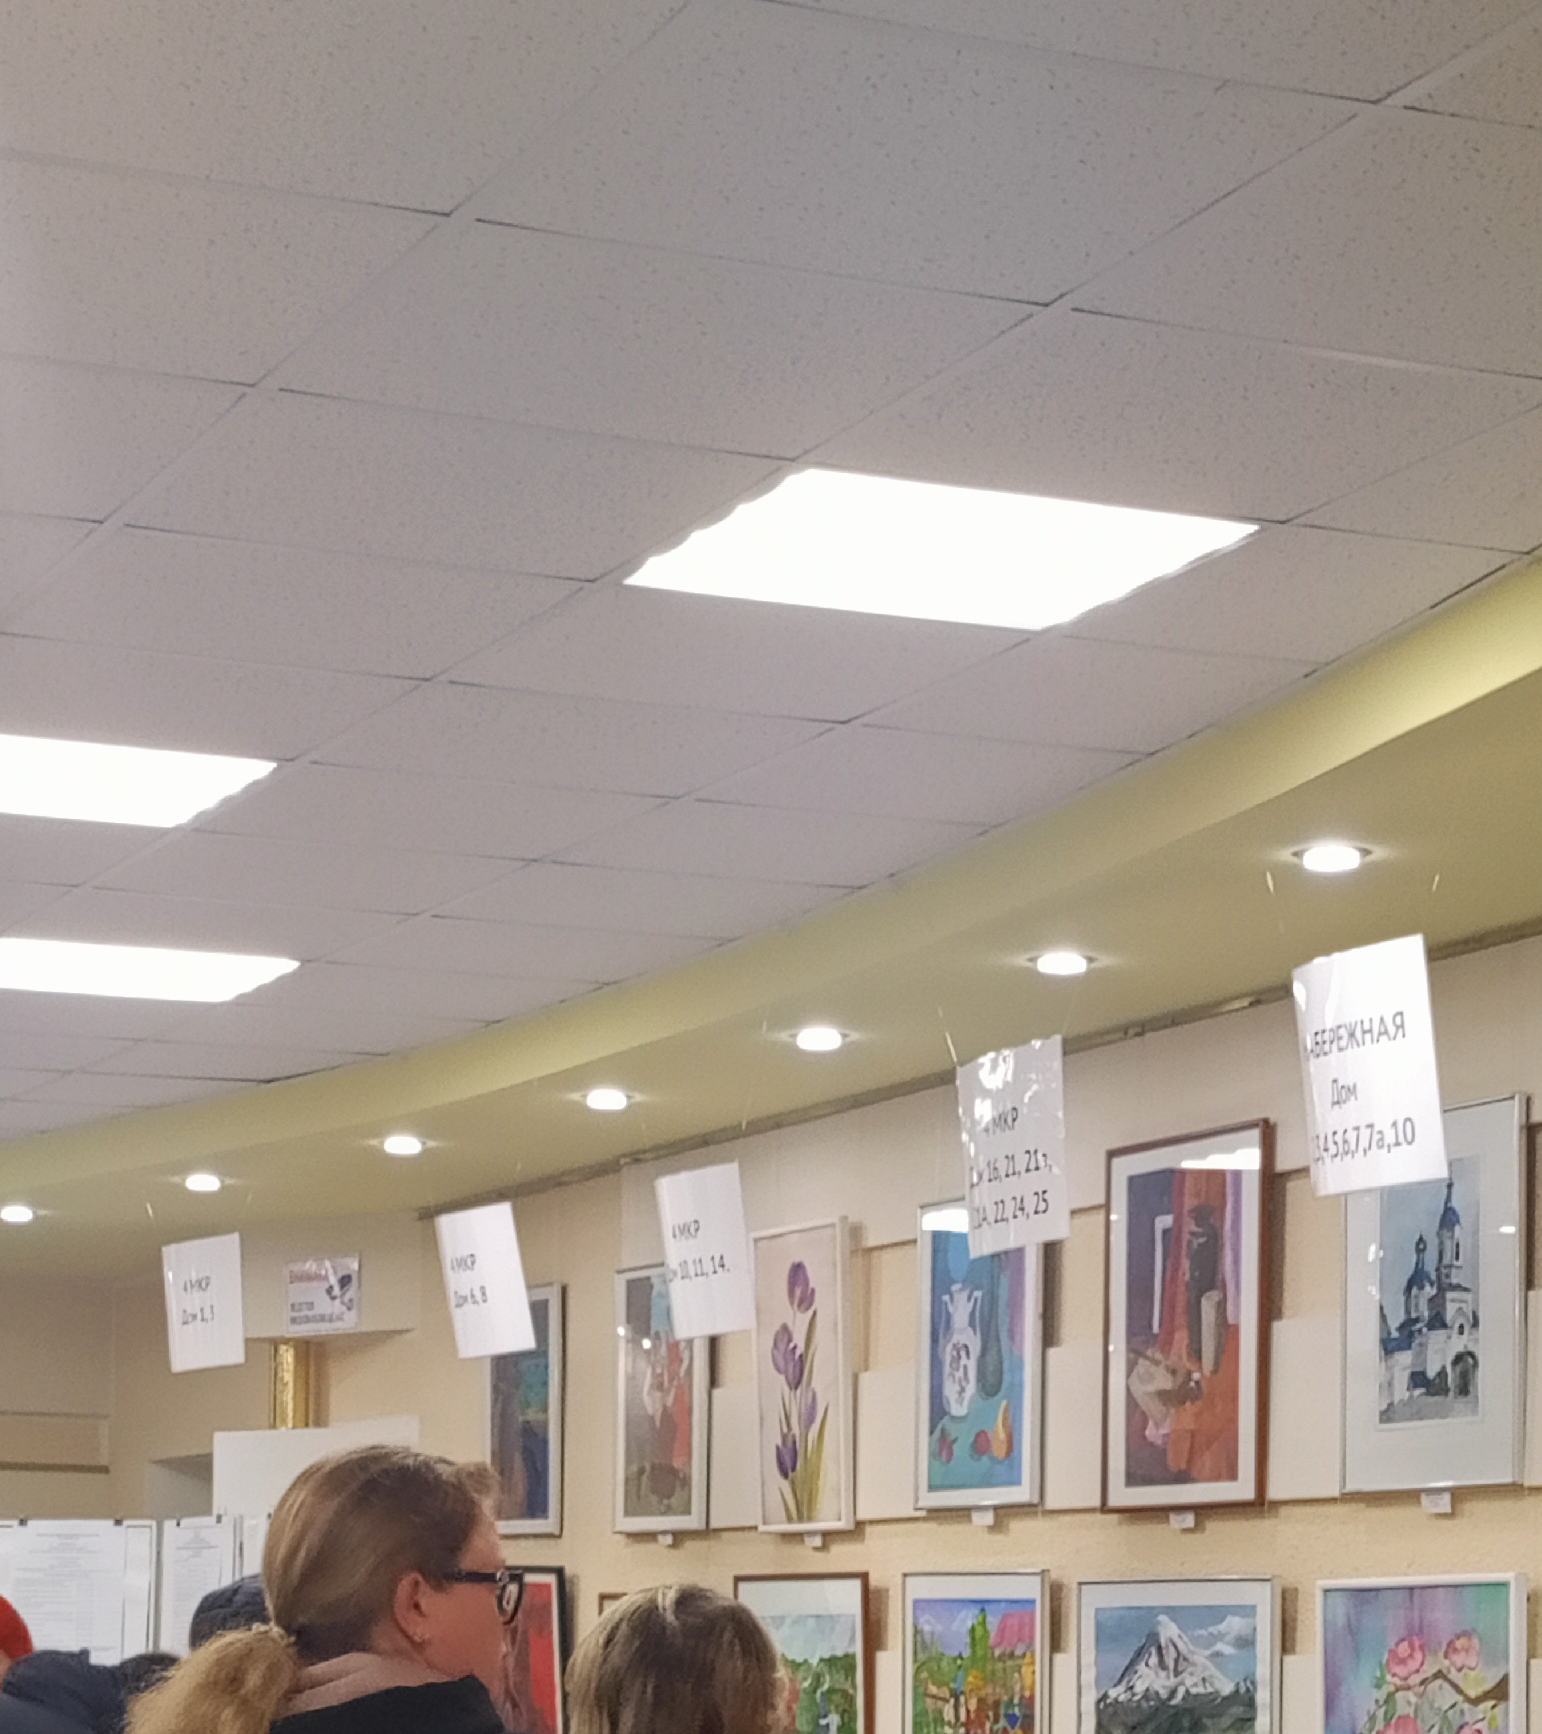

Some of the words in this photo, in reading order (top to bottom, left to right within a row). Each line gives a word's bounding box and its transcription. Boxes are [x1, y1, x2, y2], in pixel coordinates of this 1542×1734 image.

[1305, 1011, 1407, 1062] БЕРЕЖНАЯ
[1331, 1078, 1358, 1109] Дом
[1004, 1154, 1022, 1180] 21,
[1012, 1194, 1030, 1220] 24,
[1033, 1189, 1050, 1216] 25
